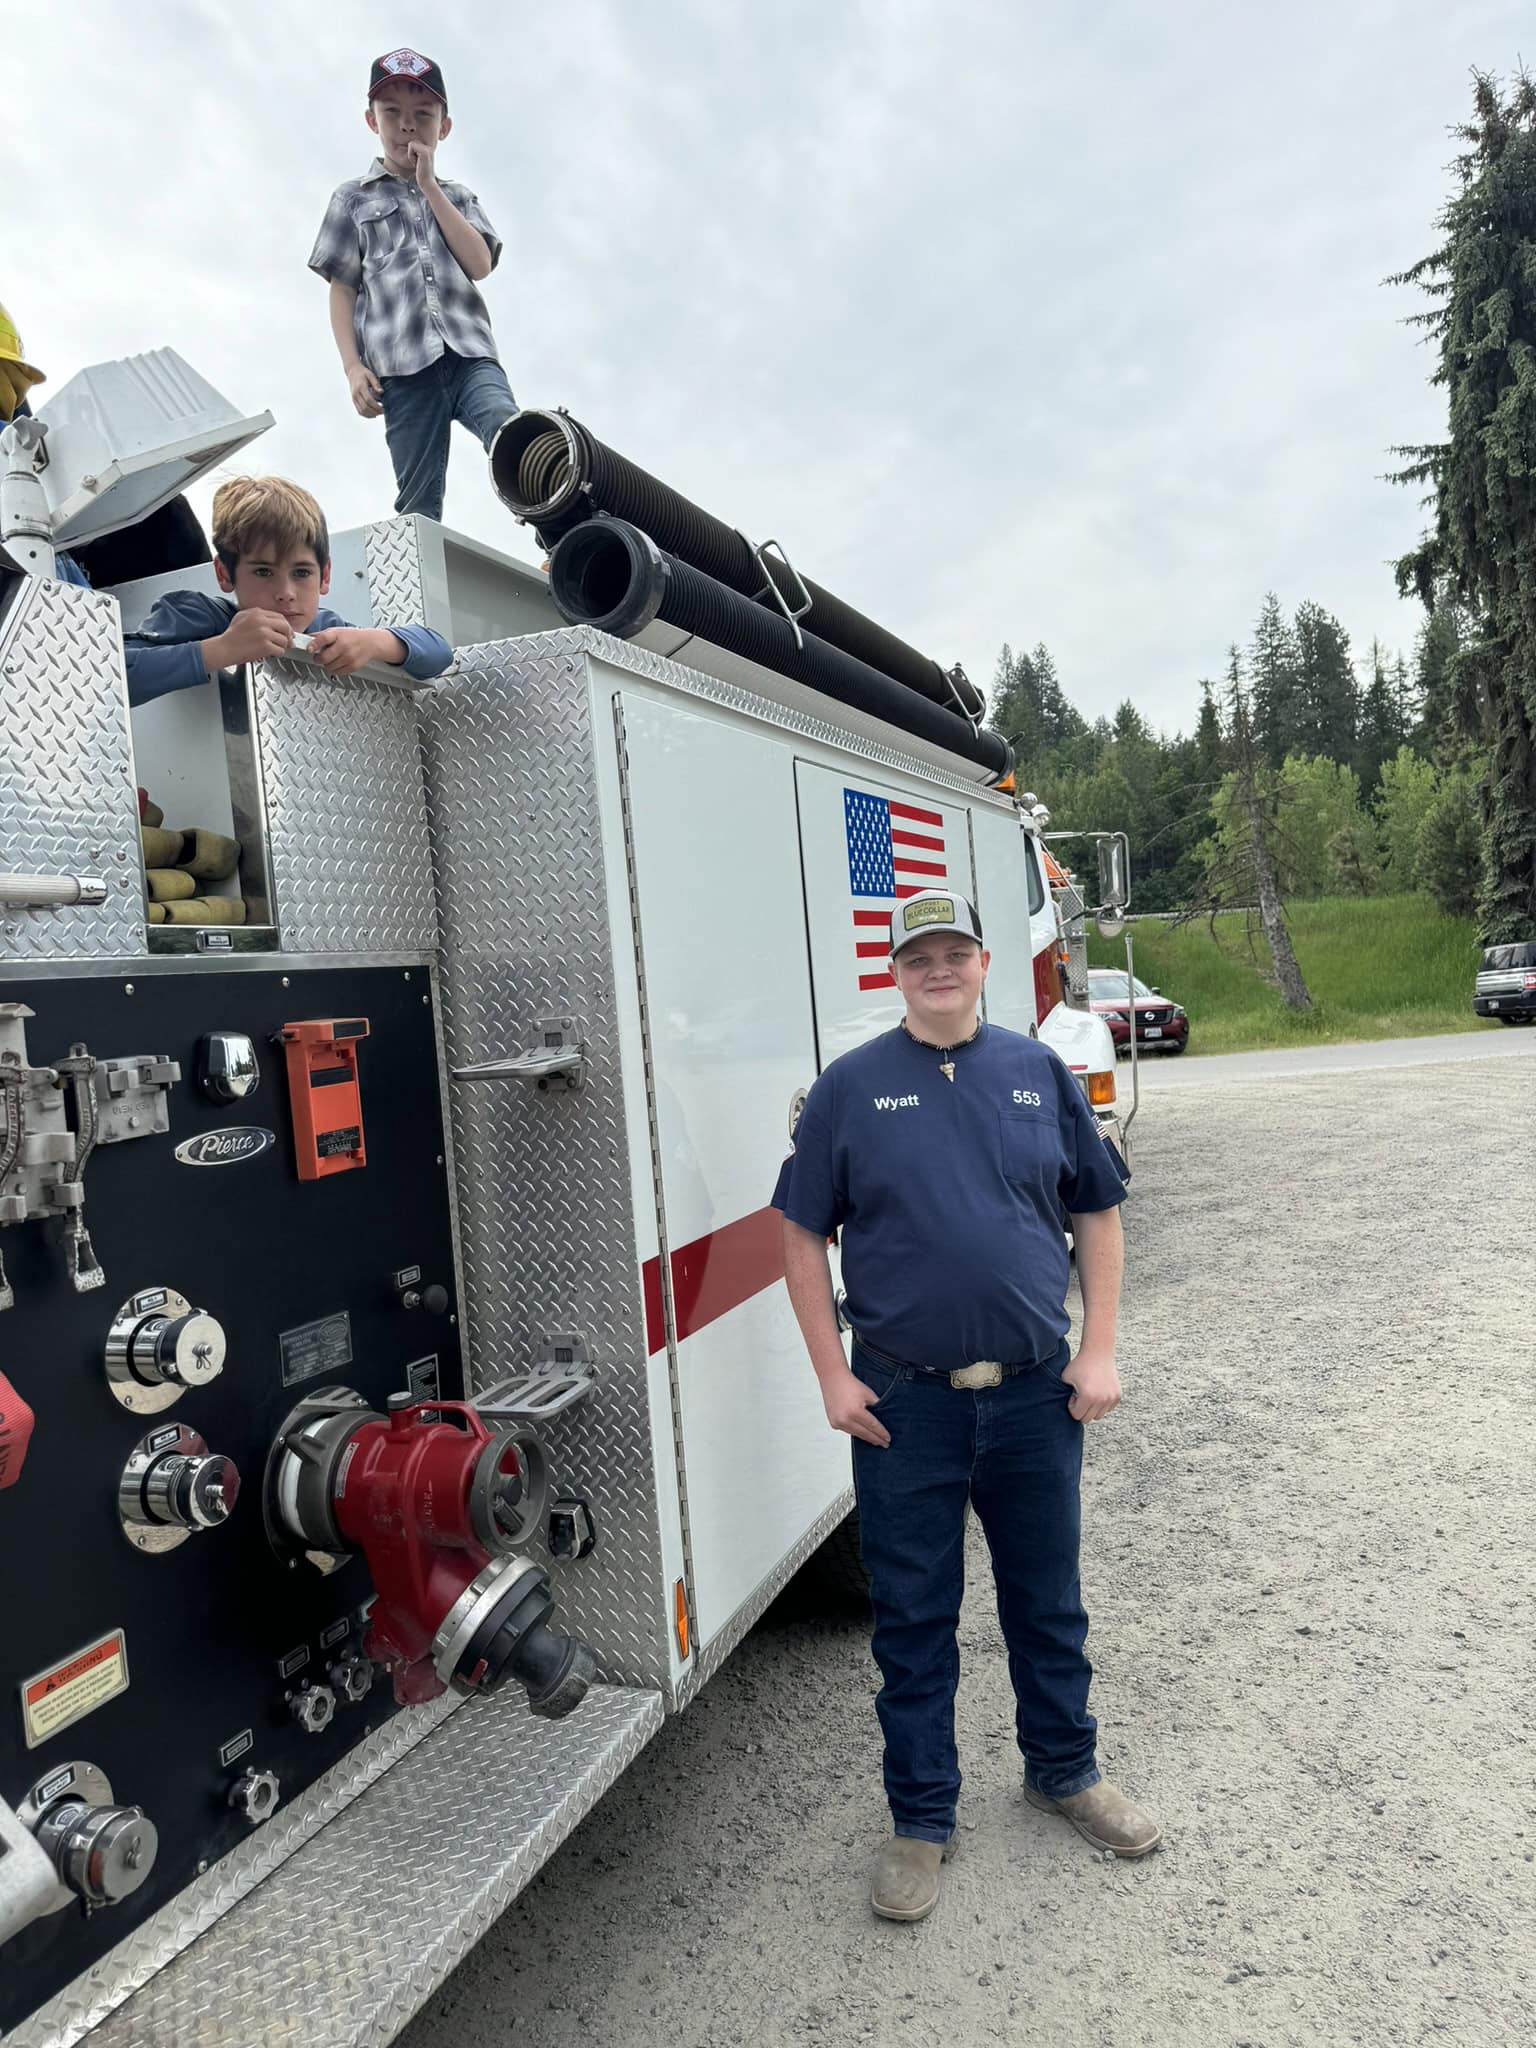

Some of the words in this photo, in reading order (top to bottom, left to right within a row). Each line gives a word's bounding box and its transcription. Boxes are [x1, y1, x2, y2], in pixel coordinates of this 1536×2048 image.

[874, 1094, 920, 1111] Wyatt
[1012, 1089, 1041, 1107] 553
[199, 1135, 254, 1161] Pierce
